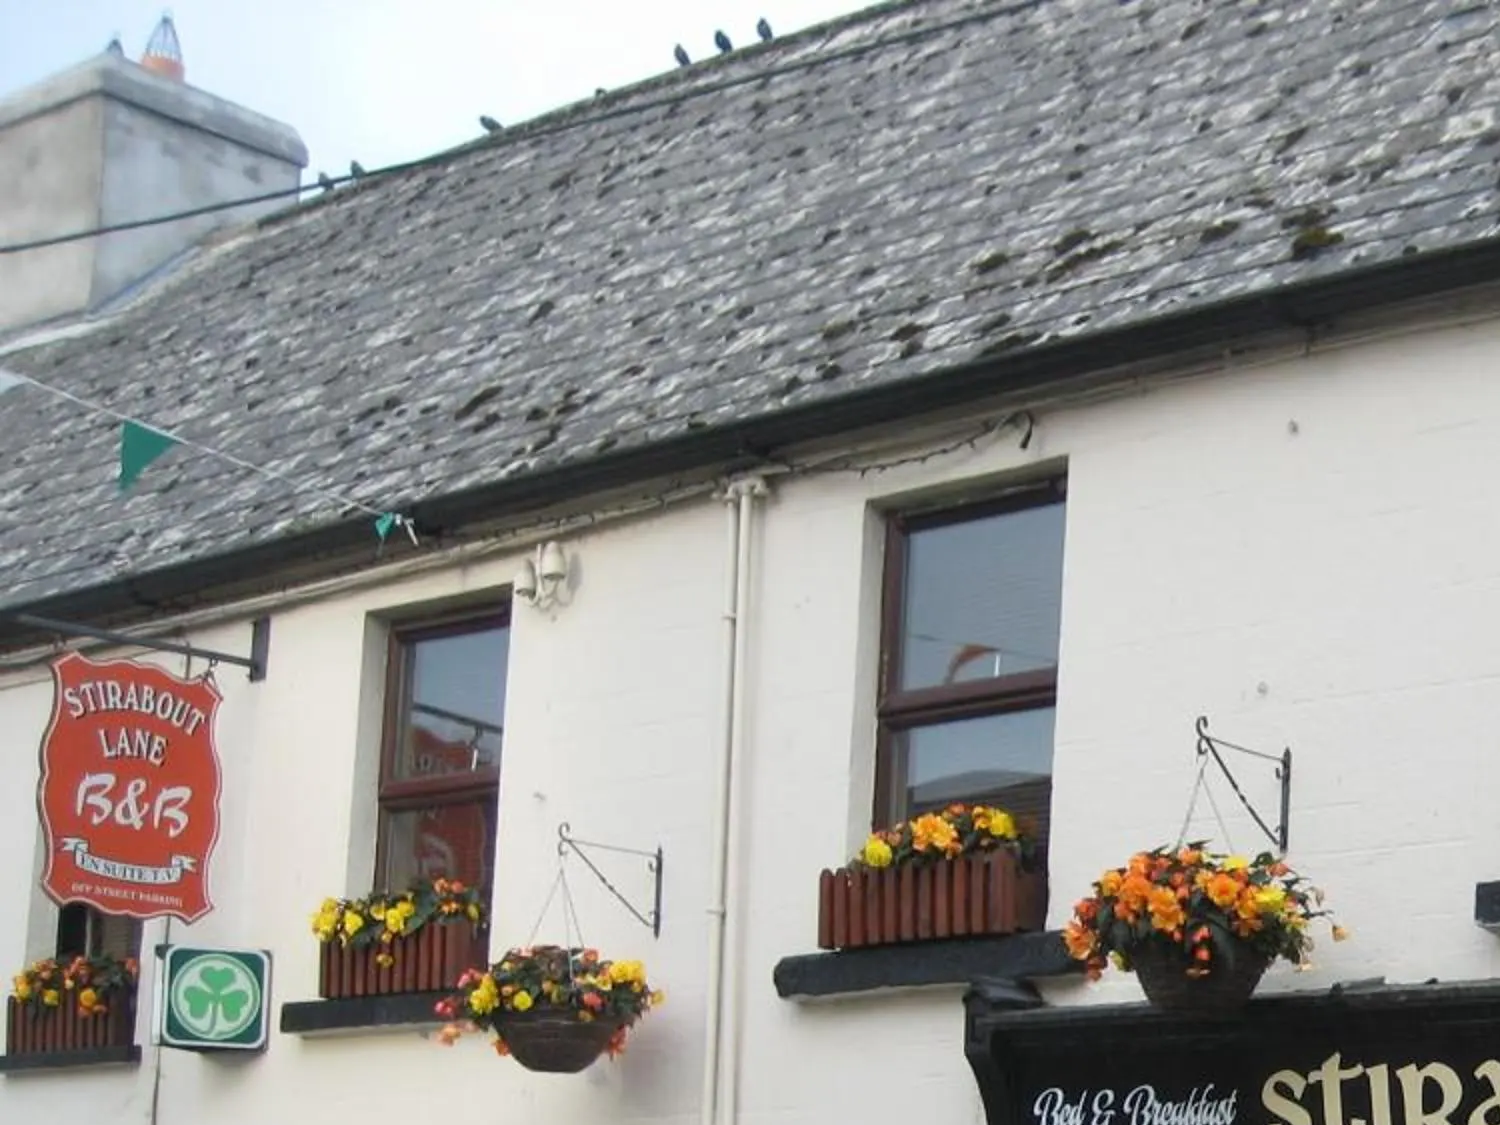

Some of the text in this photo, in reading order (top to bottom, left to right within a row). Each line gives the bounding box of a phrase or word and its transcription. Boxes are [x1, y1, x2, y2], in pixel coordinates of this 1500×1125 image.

[64, 680, 206, 737] STIRABOUT
[99, 728, 168, 765] LANE
[75, 772, 193, 838] B&B
